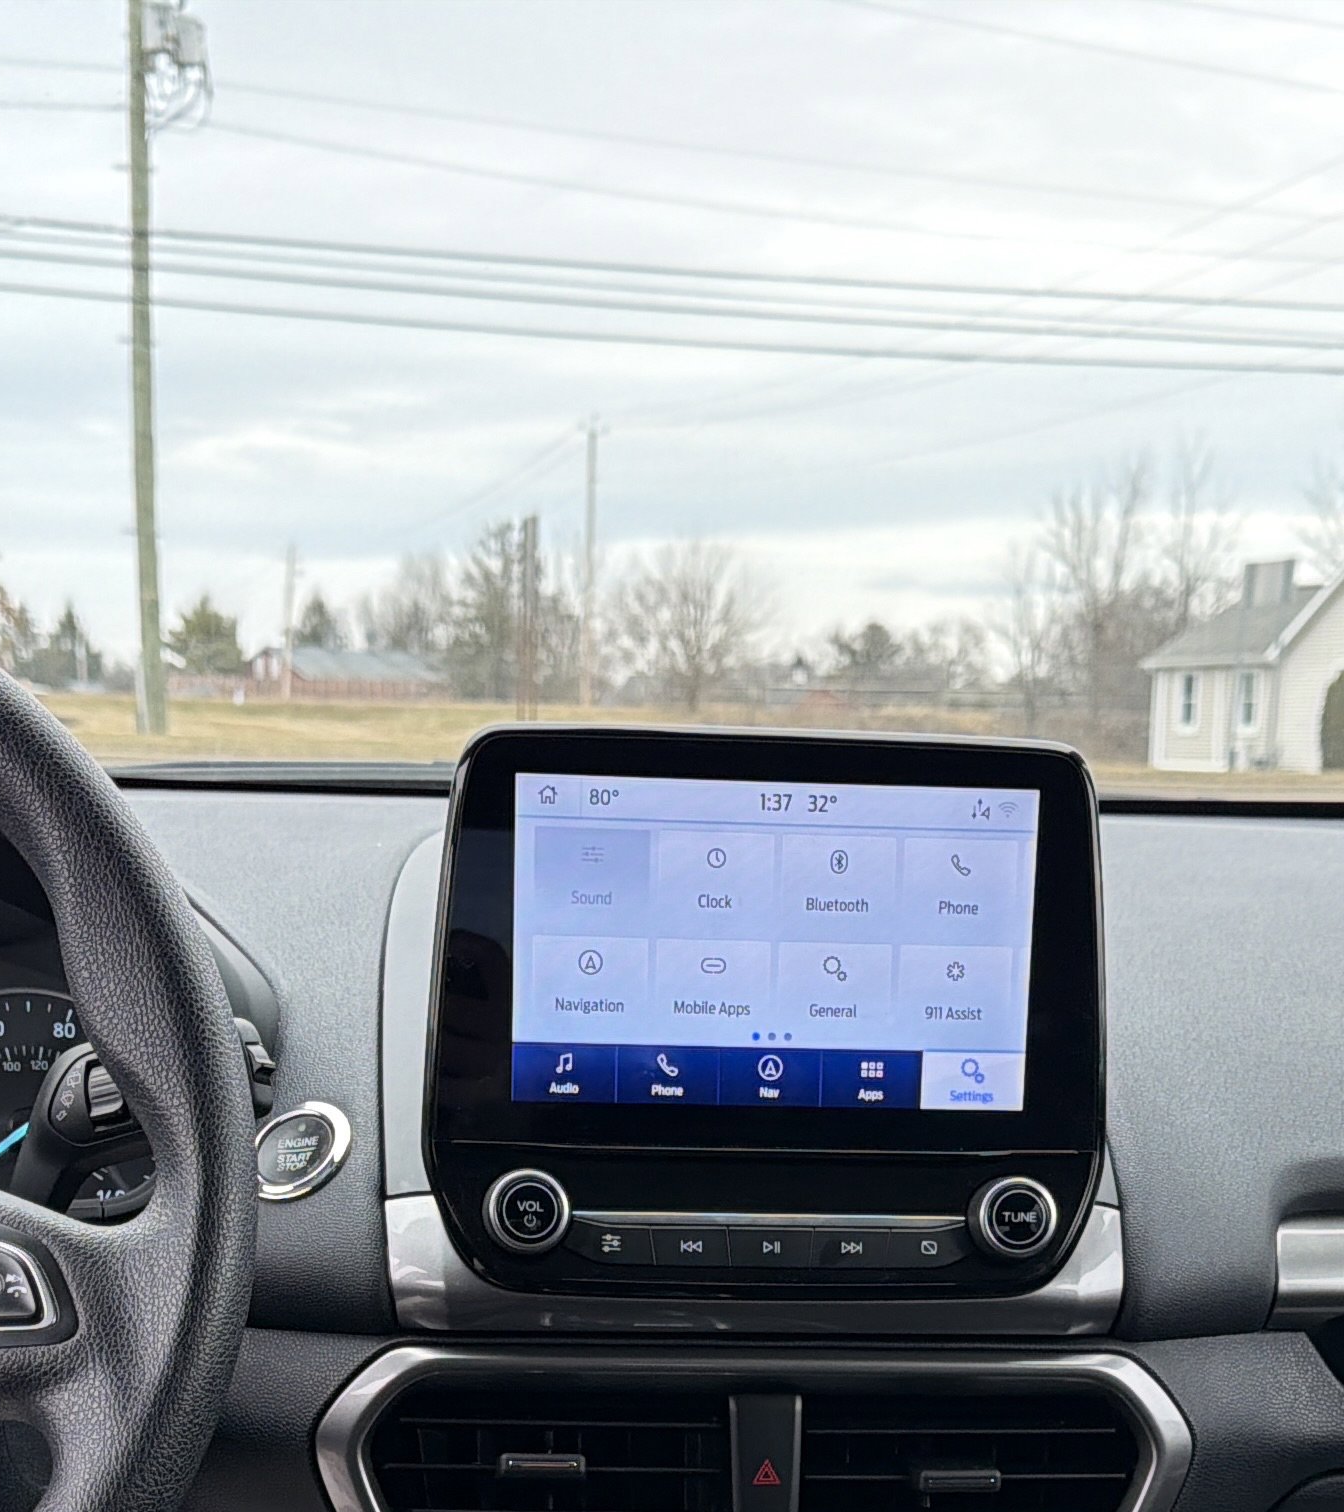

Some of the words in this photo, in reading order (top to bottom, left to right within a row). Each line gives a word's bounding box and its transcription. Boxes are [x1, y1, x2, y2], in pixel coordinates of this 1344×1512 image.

[589, 788, 619, 806] 80°
[760, 793, 792, 812] 1:37
[808, 794, 838, 813] 32°
[571, 890, 613, 906] Sound
[697, 893, 732, 910] Clock
[805, 897, 869, 914] Bluetooth
[938, 900, 979, 916] Phone
[555, 998, 625, 1016] Navigation
[673, 1000, 714, 1017] Mobile
[717, 1002, 751, 1019] Apps
[808, 1003, 857, 1019] General
[924, 1006, 944, 1021] 911
[945, 1006, 983, 1022] Assist
[53, 1022, 76, 1039] 80
[2, 1061, 21, 1072] 100
[30, 1060, 48, 1071] 120
[549, 1082, 579, 1096] Audio
[650, 1084, 684, 1098] Phone
[759, 1086, 780, 1099] Nav
[857, 1088, 884, 1103] Apps
[949, 1090, 994, 1105] Settings
[278, 1136, 319, 1148] ENGINE
[277, 1151, 312, 1164] START
[276, 1160, 308, 1173] STOP
[516, 1201, 544, 1214] VOL
[1002, 1211, 1037, 1224] TUNE
